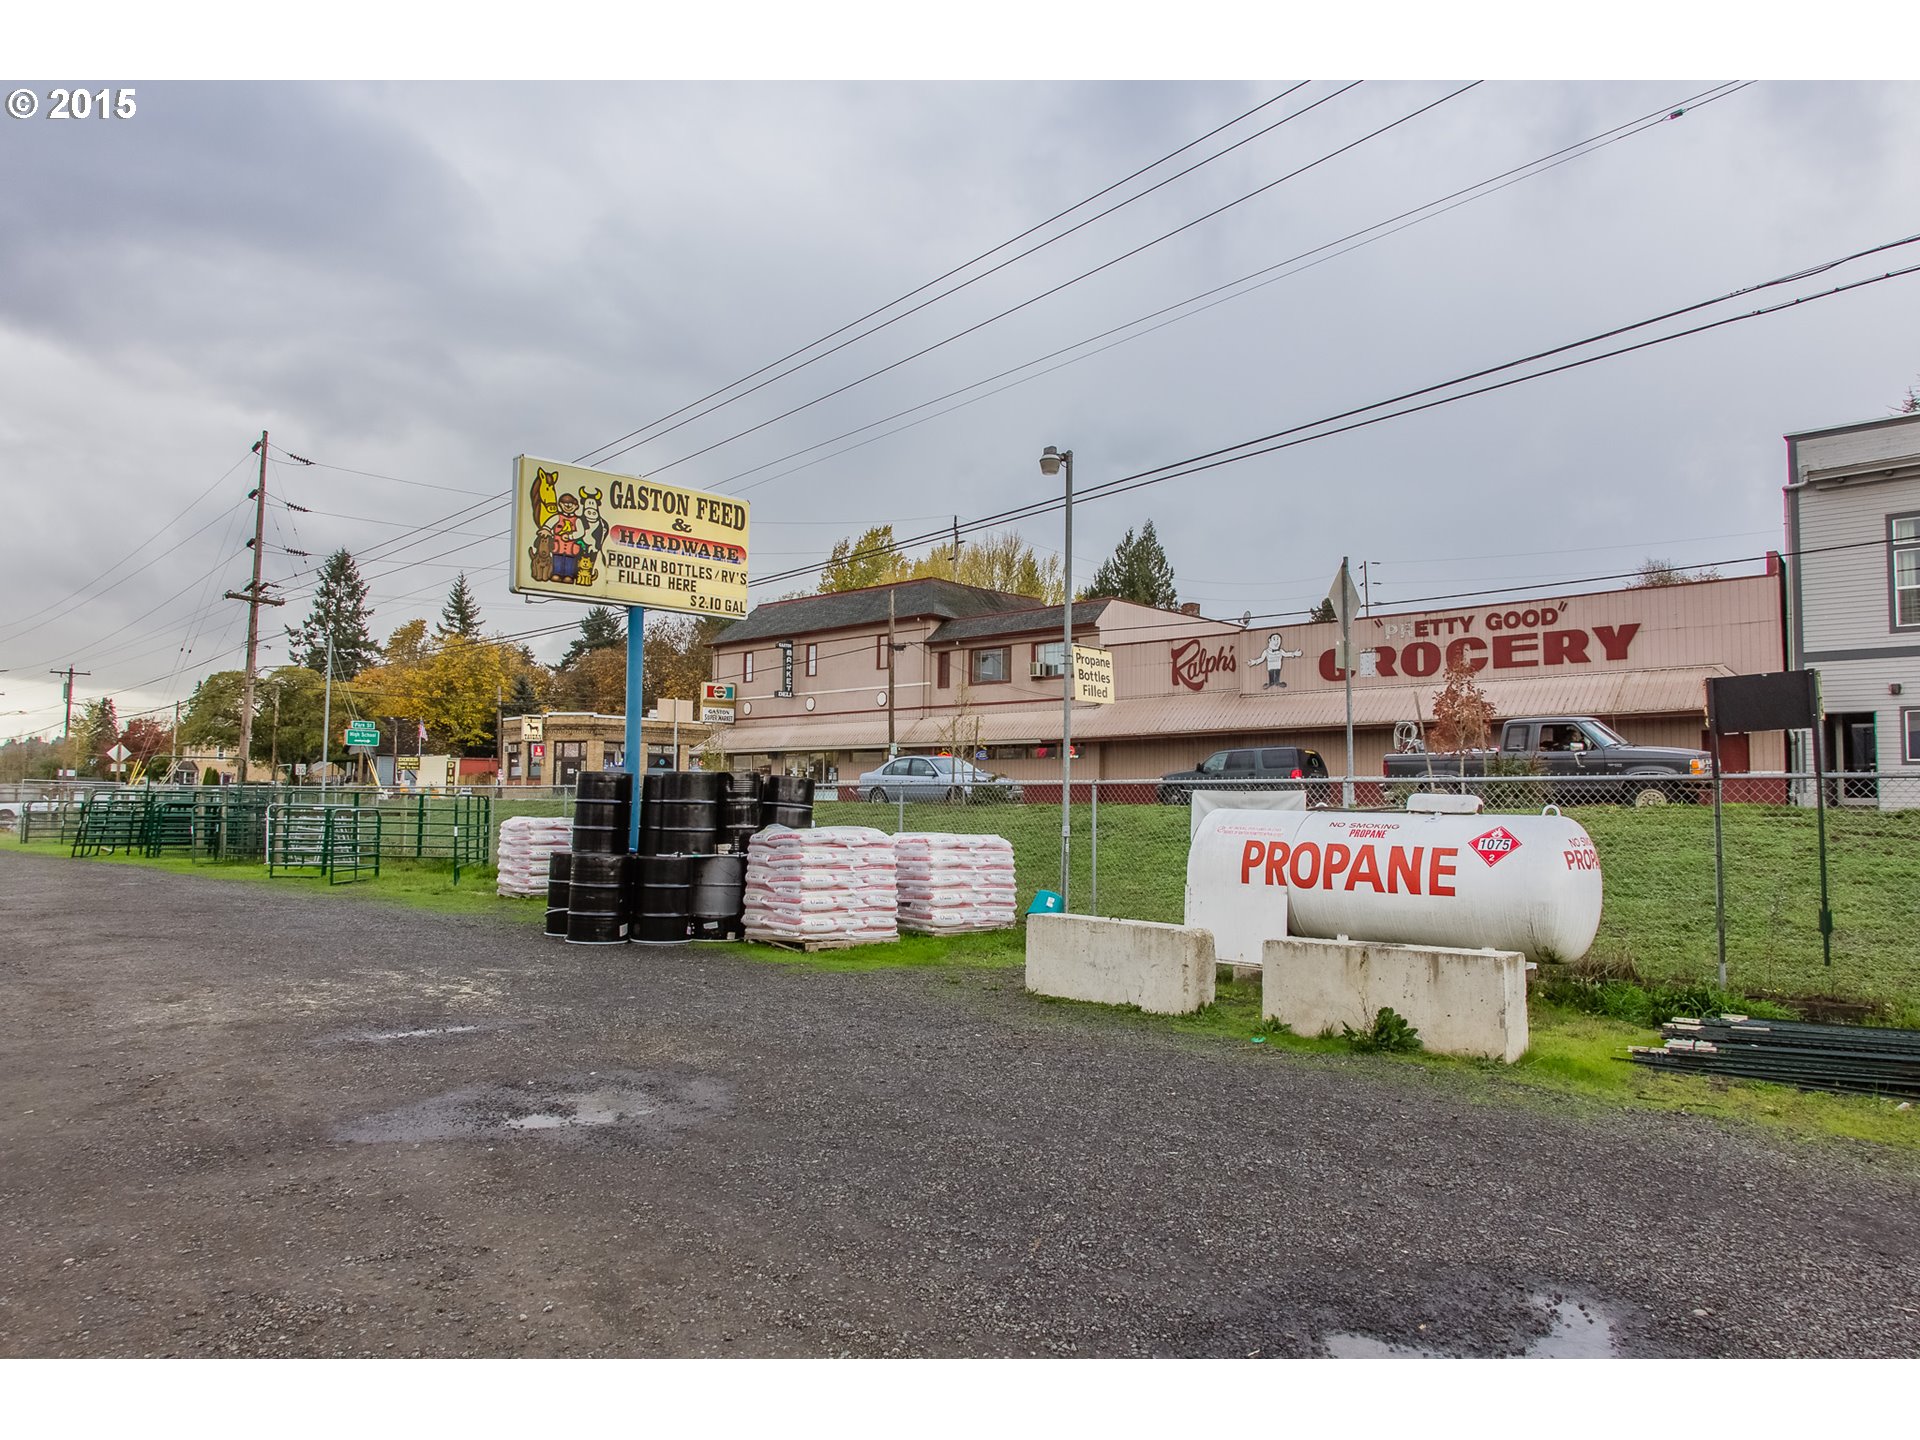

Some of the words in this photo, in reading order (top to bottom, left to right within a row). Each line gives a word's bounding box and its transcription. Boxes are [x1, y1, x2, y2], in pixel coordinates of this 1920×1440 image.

[609, 480, 690, 517] GASTON
[696, 497, 746, 532] FEED
[671, 518, 693, 533] &
[618, 528, 740, 561] HARDWARE
[608, 552, 658, 573] PROPAN
[618, 569, 661, 588] FILLED
[668, 576, 697, 593] HERE
[725, 599, 746, 614] GAL
[1075, 652, 1111, 669] Propane
[1170, 638, 1237, 692] Ralph's
[785, 649, 793, 692] MARKET
[1078, 668, 1111, 684] Bottles
[1082, 684, 1108, 698] Filled
[1348, 822, 1400, 830] SMOKING
[1348, 829, 1388, 839] PROPANE
[1480, 839, 1511, 851] 1075
[1488, 854, 1495, 862] 2
[1240, 839, 1459, 897] PROPANE
